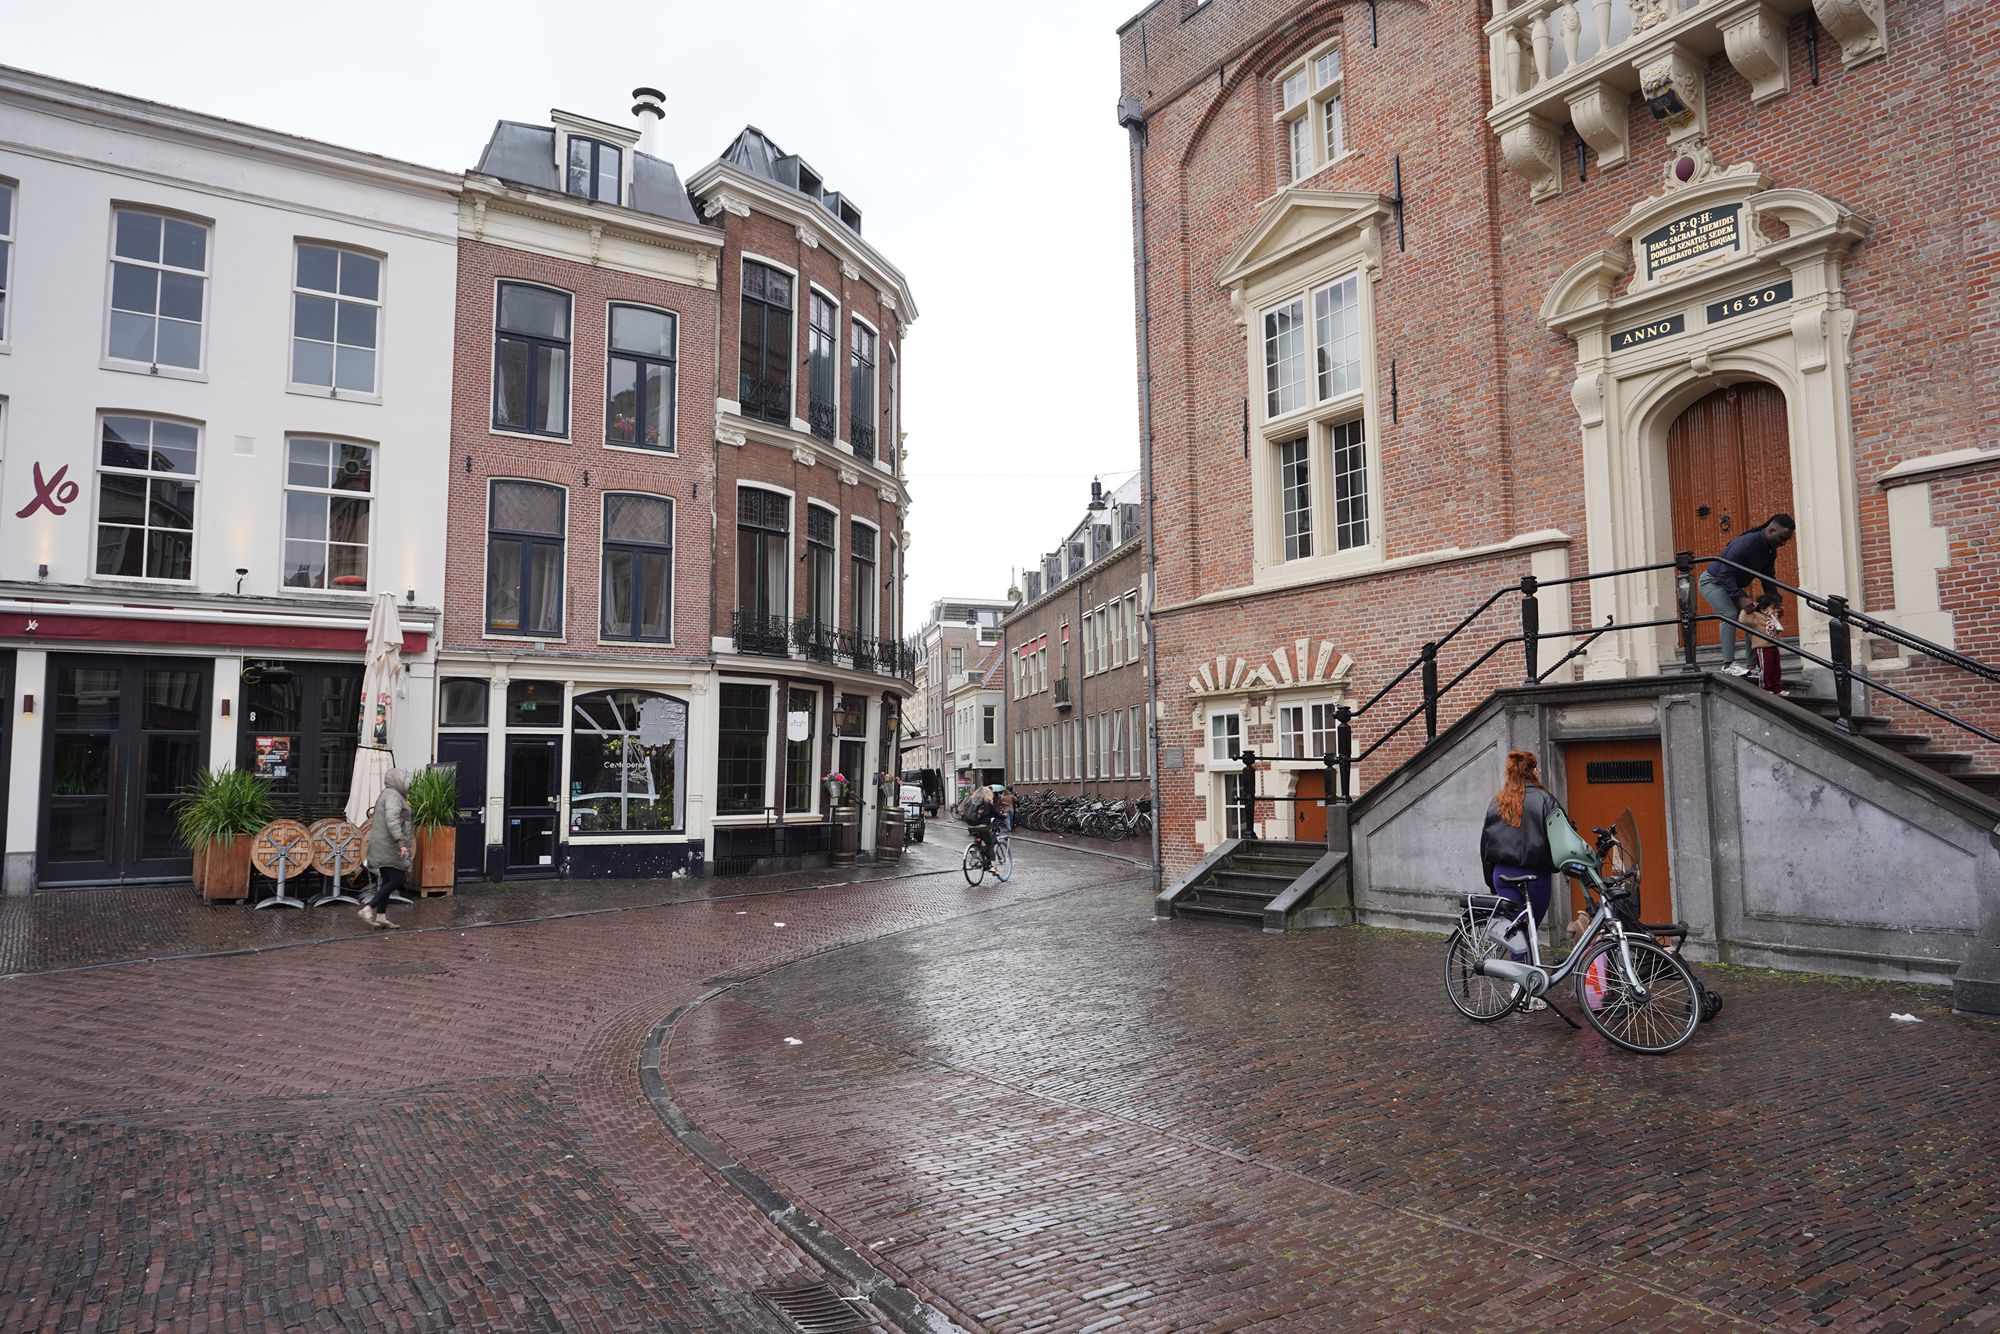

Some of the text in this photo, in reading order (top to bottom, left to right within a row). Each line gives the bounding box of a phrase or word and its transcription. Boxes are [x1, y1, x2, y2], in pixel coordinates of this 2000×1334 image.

[1650, 215, 1735, 251] HANC SACRAM THEMIDIS
[1650, 225, 1734, 260] DOMUM SENATUS SEDEM
[1651, 260, 1659, 268] NE
[1660, 249, 1692, 265] TEMERATO
[1710, 233, 1737, 248] UNQUAM
[1722, 290, 1776, 316] 1630
[1622, 322, 1671, 346] ANNO
[249, 711, 256, 722] 8
